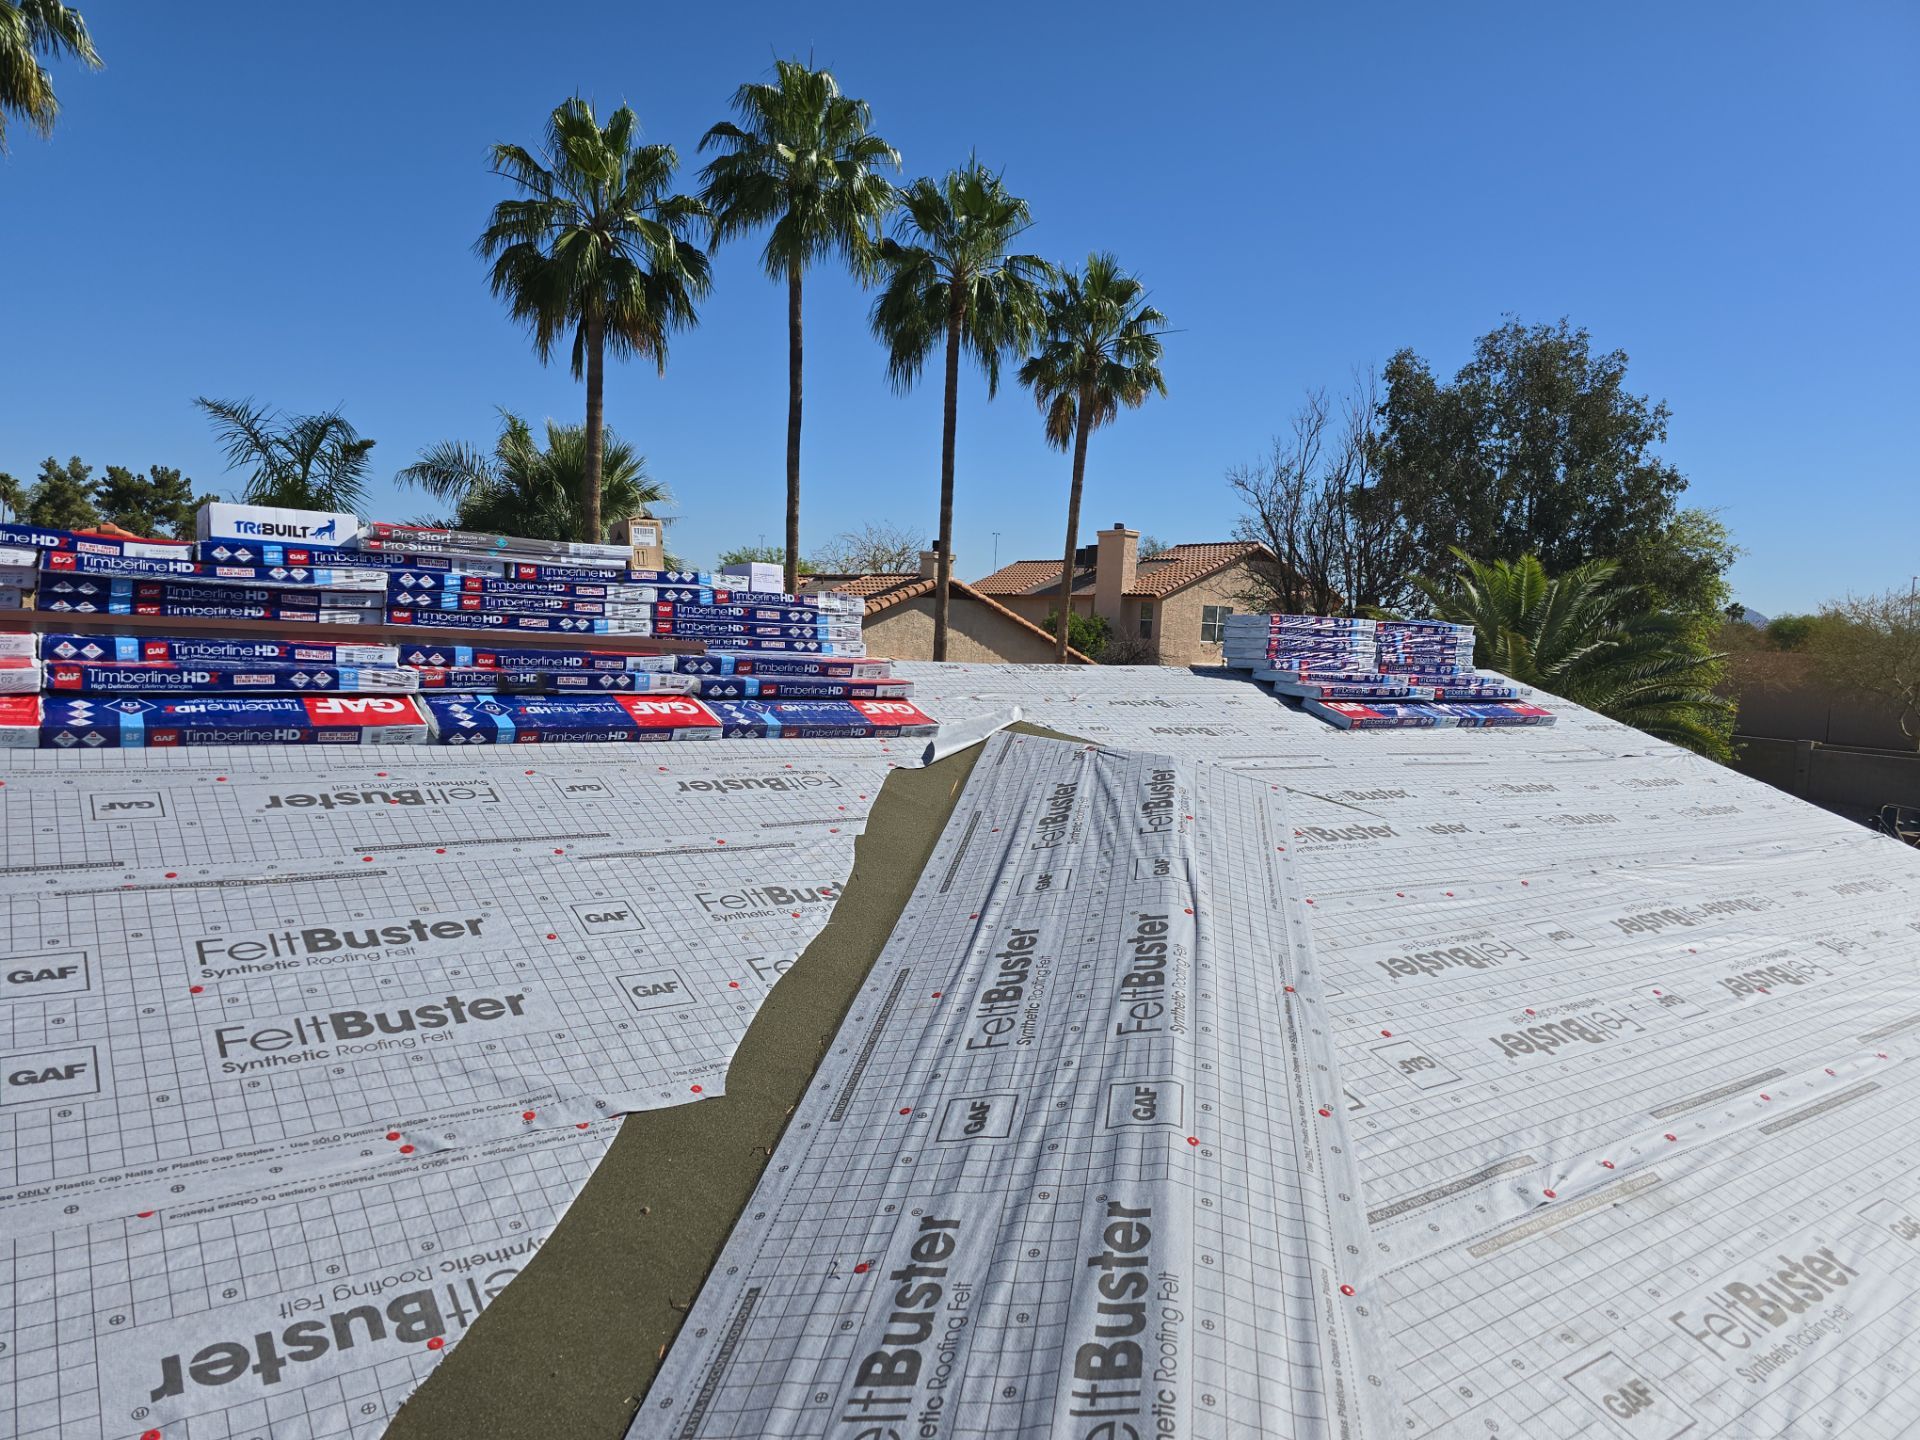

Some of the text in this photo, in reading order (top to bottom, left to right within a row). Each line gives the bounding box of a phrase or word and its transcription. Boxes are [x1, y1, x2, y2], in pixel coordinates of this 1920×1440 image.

[83, 552, 202, 574] Timberline HDZ
[312, 552, 383, 563] Timberline
[542, 566, 598, 578] Timberline
[486, 578, 548, 590] Timberline
[166, 585, 244, 600] Timberline
[733, 591, 780, 601] Timberline
[167, 604, 242, 616] Timberline
[484, 596, 544, 608] Timberline
[544, 599, 569, 609] HDZ
[676, 604, 728, 616] Timberline
[418, 611, 482, 623] Timberline
[676, 620, 728, 632] Timberline
[120, 646, 134, 654] SF
[172, 643, 252, 656] Timberline
[254, 645, 288, 656] HDZ
[499, 656, 562, 666] Timberline
[564, 657, 590, 667] HDZ
[754, 662, 804, 672] Timberline
[1, 676, 12, 684] 02
[57, 668, 218, 684] GAF Timberline HDZ
[780, 684, 826, 694] Timberline
[164, 703, 303, 713] Timberline HDZ
[316, 698, 406, 714] GAF
[551, 706, 624, 714] Timberline
[632, 702, 699, 714] GAF
[861, 702, 915, 714] GAF
[2, 734, 14, 742] 02
[184, 730, 272, 741] Timberline
[274, 729, 310, 740] HDZ
[542, 732, 607, 742] Timberline
[608, 732, 634, 741] HDZ
[802, 728, 850, 736] Timberline
[332, 779, 490, 792] Synthetic Roofing Felt
[566, 784, 602, 792] GAF
[678, 775, 842, 794] FeltBuster
[100, 800, 155, 811] GAF
[264, 788, 500, 810] FeltBuster
[1138, 768, 1176, 834] FeltBuster
[1030, 782, 1078, 850] FeltBuster
[1154, 858, 1170, 876] GAF
[1036, 874, 1052, 890] GAF
[584, 910, 630, 925] GAF
[712, 904, 828, 922] Synthetic Roofing
[196, 916, 484, 966] FeltBuster
[202, 946, 416, 980] Synthetic Roofing Felt
[1376, 941, 1530, 978] FeltBuster
[7, 966, 78, 984] GAF
[1116, 912, 1168, 1036] FeltBuster
[1717, 958, 1834, 997] FeltBuster
[632, 981, 678, 998] GAF
[966, 928, 1040, 1050] FeltBuster
[1017, 955, 1051, 1046] Synthetic Roofing Felt
[1170, 999, 1187, 1034] Synthetic
[215, 992, 526, 1058] FeltBuster
[1489, 1008, 1646, 1058] FeltBuster
[222, 1030, 454, 1074] Synthetic Roofing Felt
[1400, 1055, 1436, 1074] GAF
[8, 1063, 87, 1087] GAF
[1132, 1087, 1158, 1121] GAF
[964, 1102, 991, 1135] GAF
[18, 1186, 51, 1198] ONLY
[56, 1178, 95, 1192] Plastic
[99, 1174, 122, 1184] Cap
[125, 1169, 152, 1179] Nails
[172, 1158, 208, 1170] Plastic
[212, 1154, 232, 1163] Cap
[236, 1148, 275, 1159] Staples
[290, 1140, 310, 1148] Use
[439, 1110, 470, 1120] Grapas
[487, 1101, 518, 1112] Cabeza
[483, 1144, 516, 1156] Staples
[450, 1155, 470, 1163] Use
[262, 1194, 276, 1202] De
[279, 1186, 316, 1198] Grapas
[218, 1197, 258, 1210] Cabeza
[280, 1264, 434, 1320] Roofing Felt
[1668, 1246, 1860, 1362] FeltBuster
[1154, 1271, 1184, 1384] Roofing Felt
[928, 1281, 973, 1392] Roofing Felt
[1332, 1341, 1342, 1368] Grapas
[1735, 1341, 1798, 1384] Synthetic
[1602, 1378, 1654, 1420] GAF
